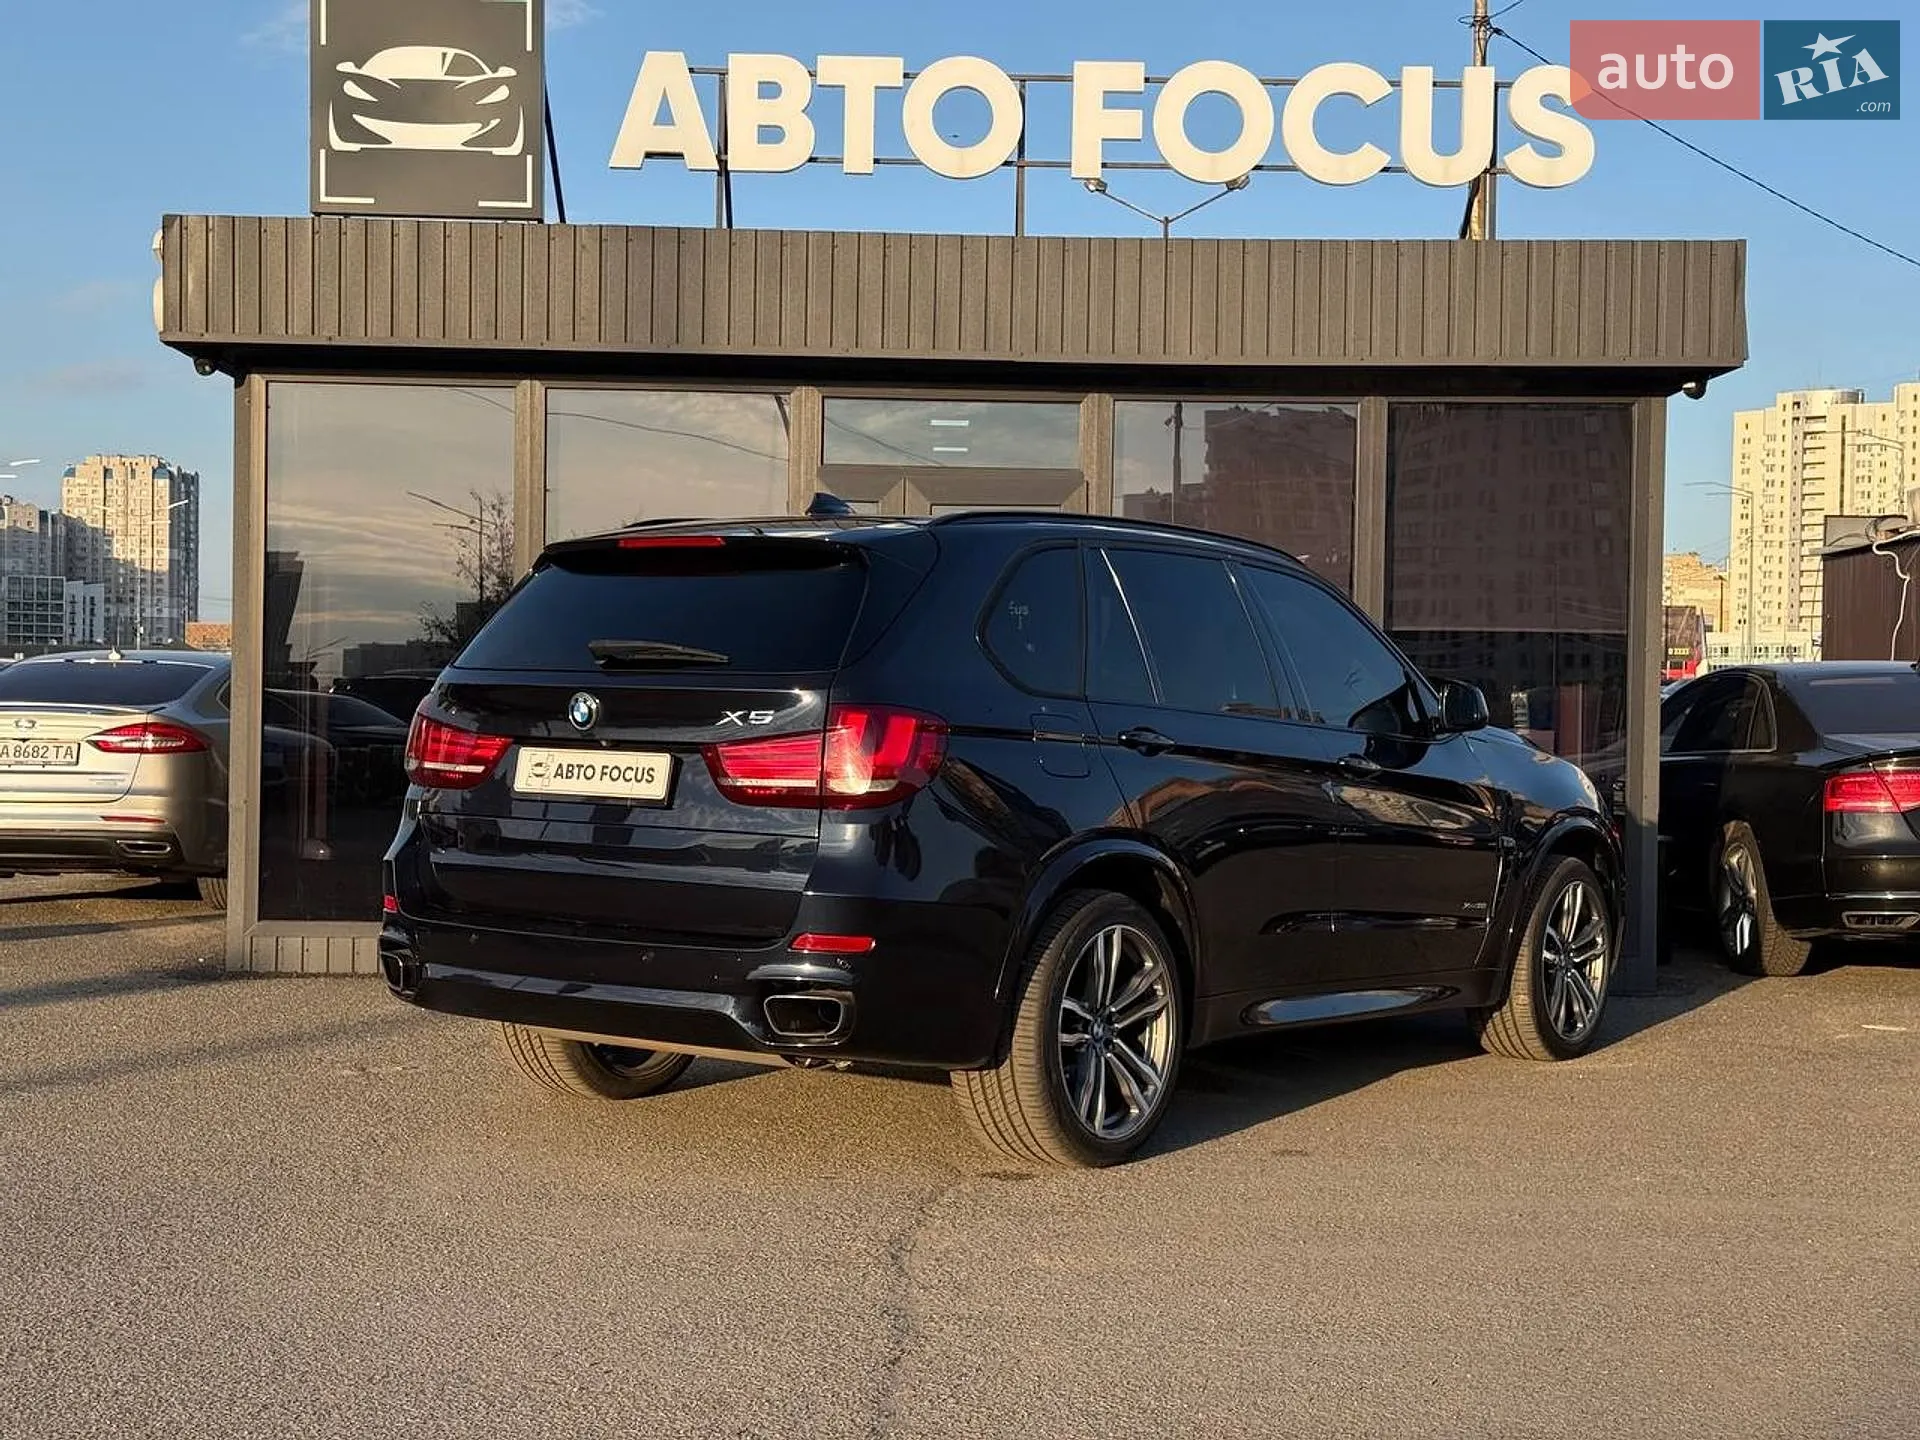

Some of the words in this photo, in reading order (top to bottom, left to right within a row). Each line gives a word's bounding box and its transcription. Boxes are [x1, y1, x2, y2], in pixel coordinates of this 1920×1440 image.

[1071, 60, 1596, 189] FOCUS
[715, 710, 775, 726] X5
[13, 744, 49, 759] 8682
[53, 745, 73, 760] TA
[600, 765, 656, 784] FOCUS
